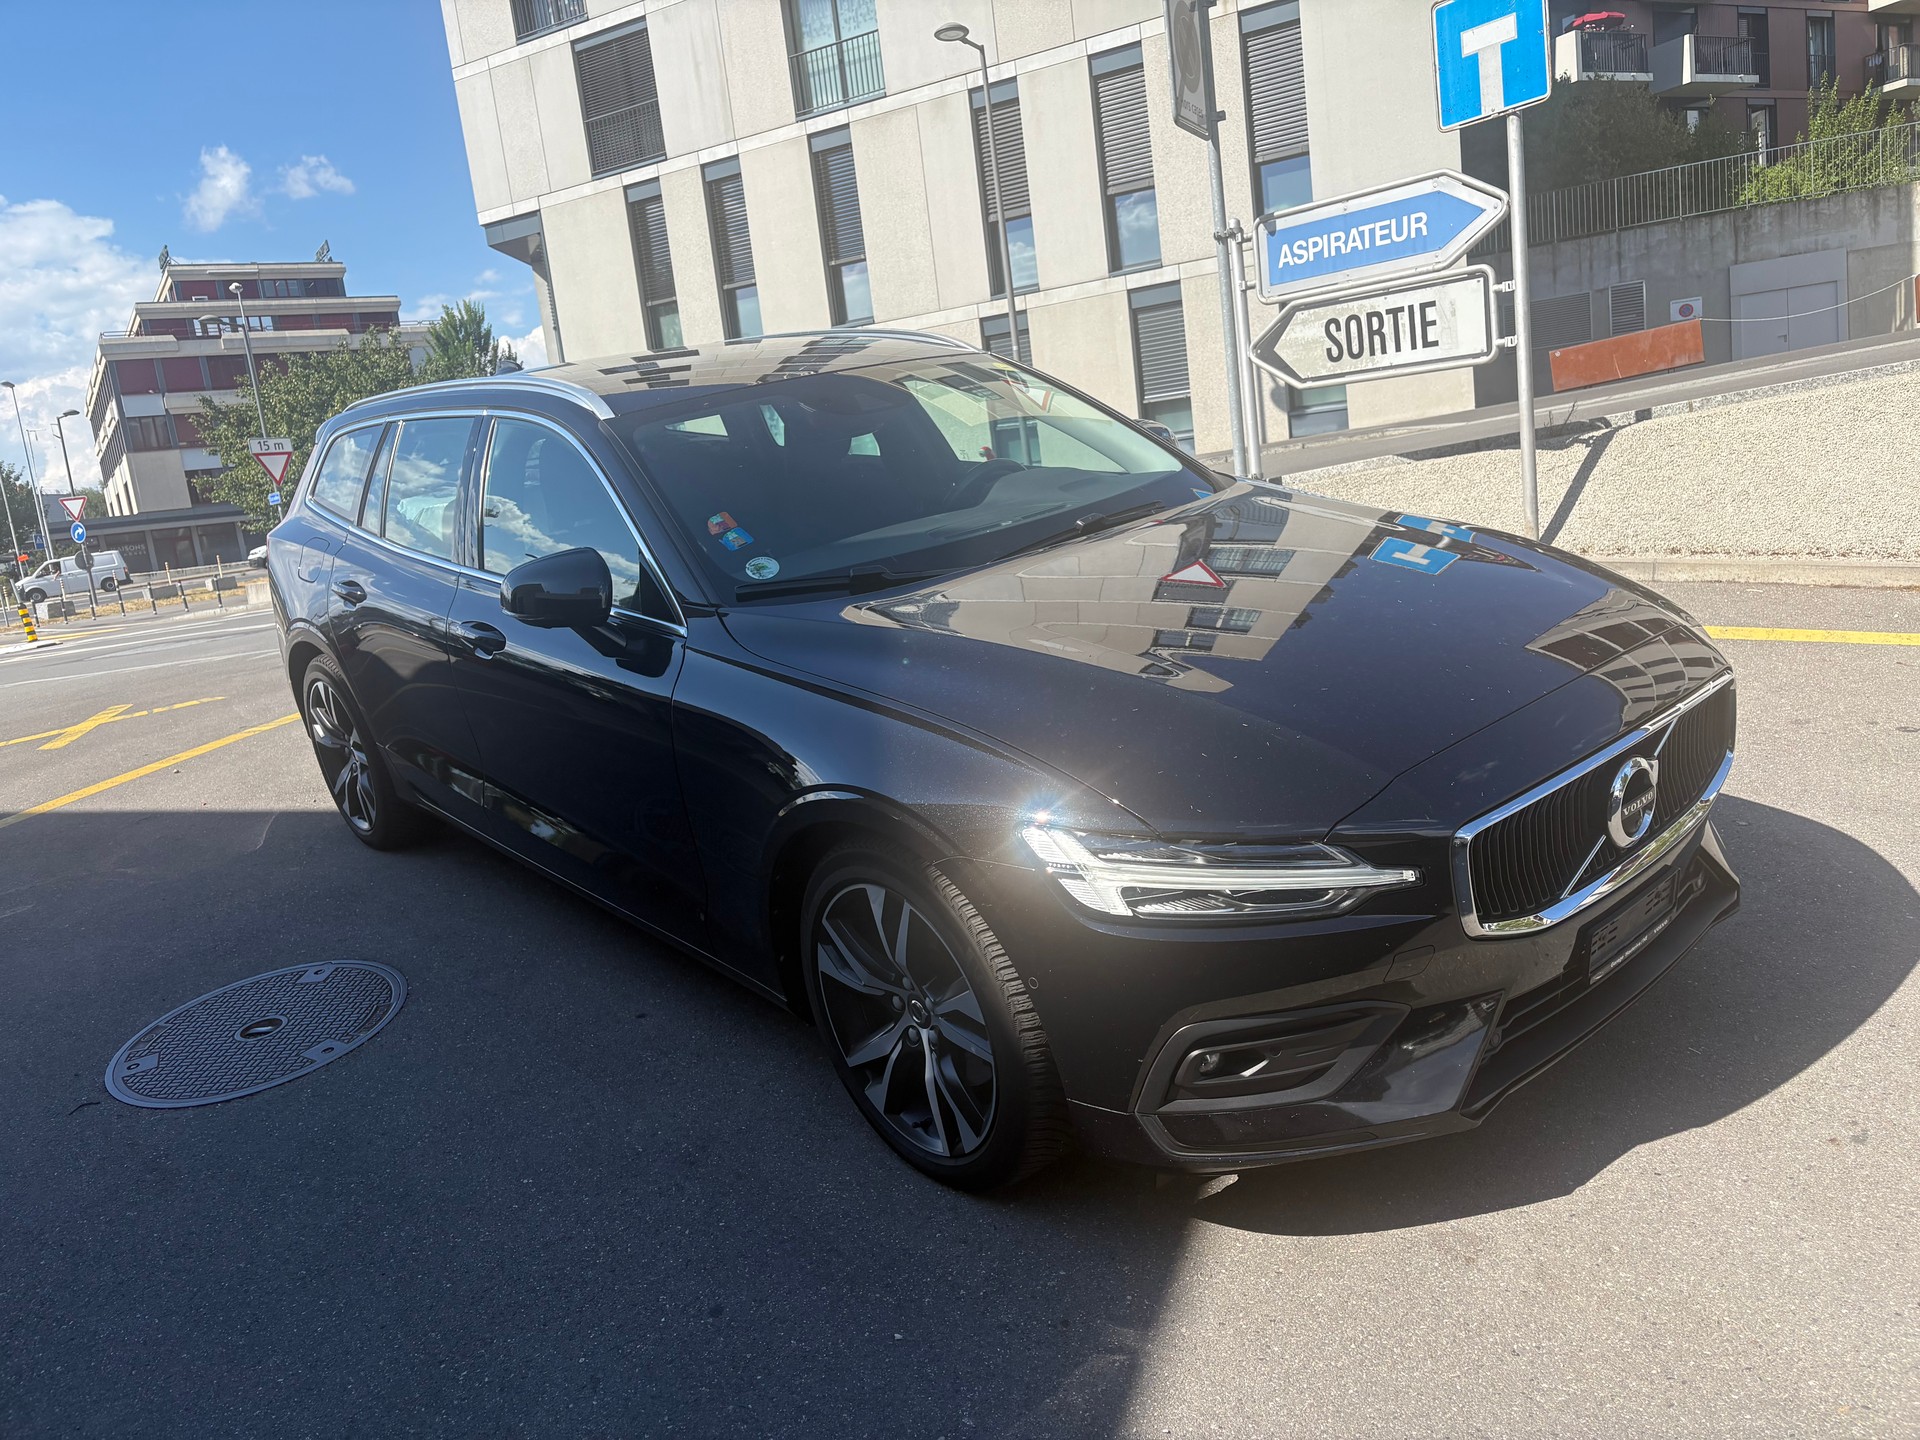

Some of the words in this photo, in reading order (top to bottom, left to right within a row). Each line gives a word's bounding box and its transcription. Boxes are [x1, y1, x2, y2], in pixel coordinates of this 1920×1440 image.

[1278, 211, 1428, 268] ASPIRATEUR
[1324, 300, 1439, 363] SORTIE
[257, 440, 270, 451] 15
[273, 442, 284, 451] m
[1622, 791, 1654, 816] VOLVO
